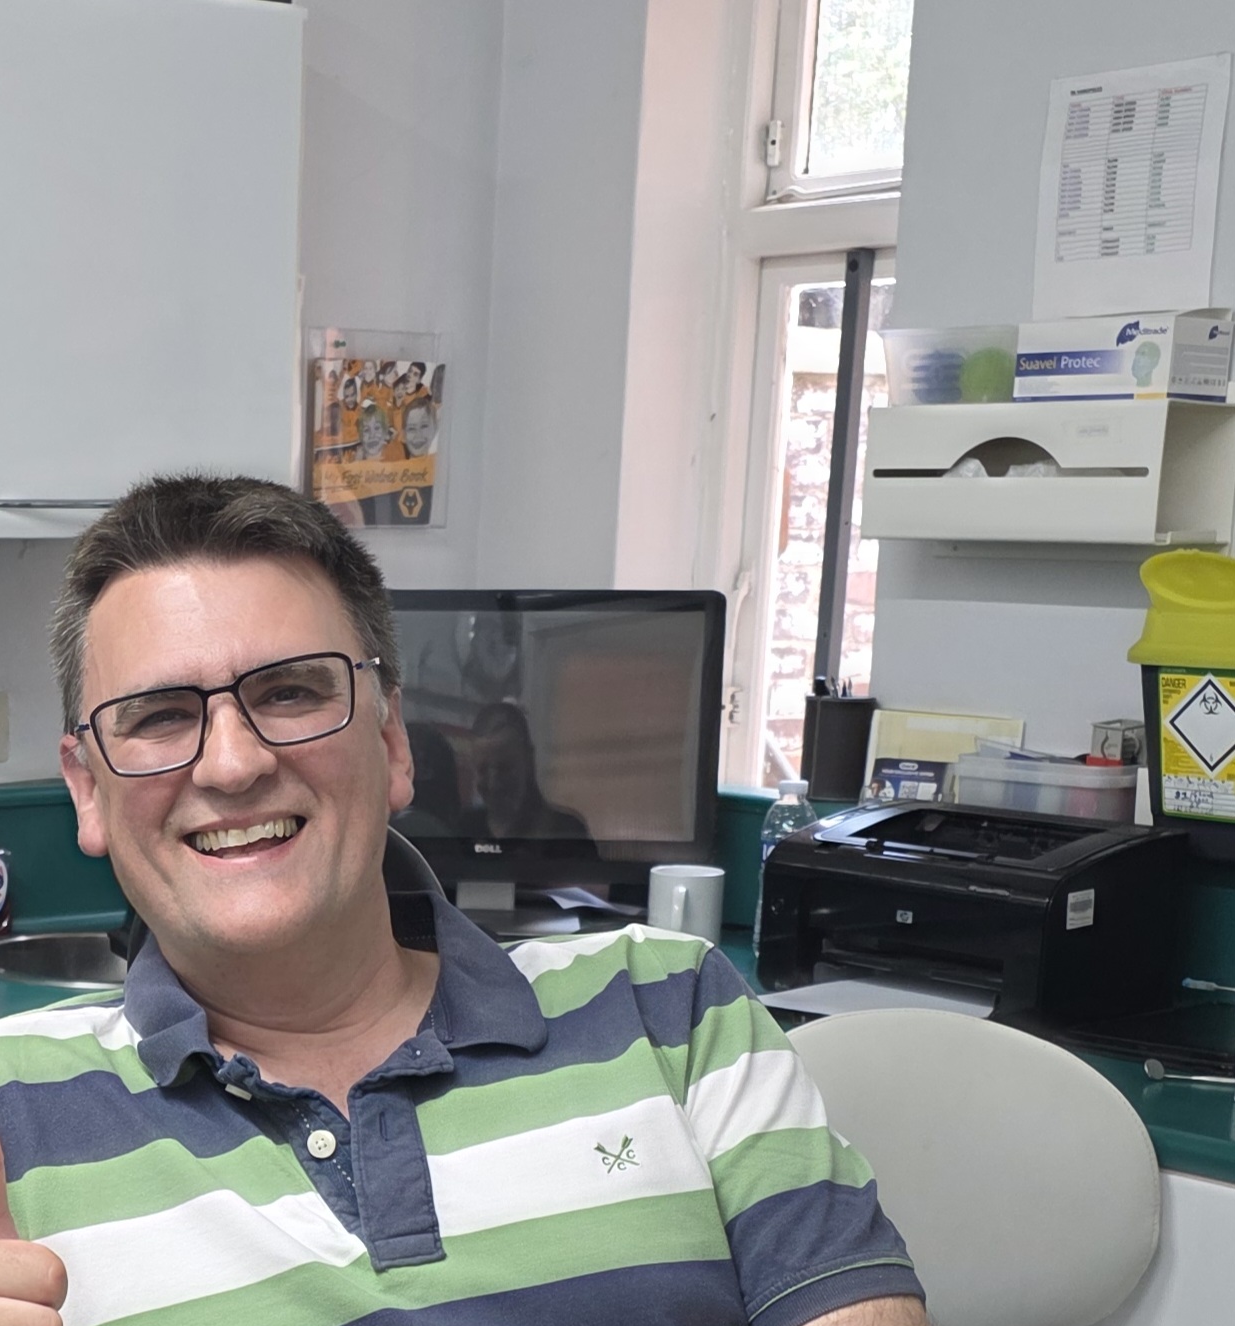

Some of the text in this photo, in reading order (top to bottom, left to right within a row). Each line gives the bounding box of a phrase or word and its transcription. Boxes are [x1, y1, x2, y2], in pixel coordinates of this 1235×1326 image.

[1019, 356, 1101, 371] Suavel Protec
[1161, 677, 1186, 689] DANGER
